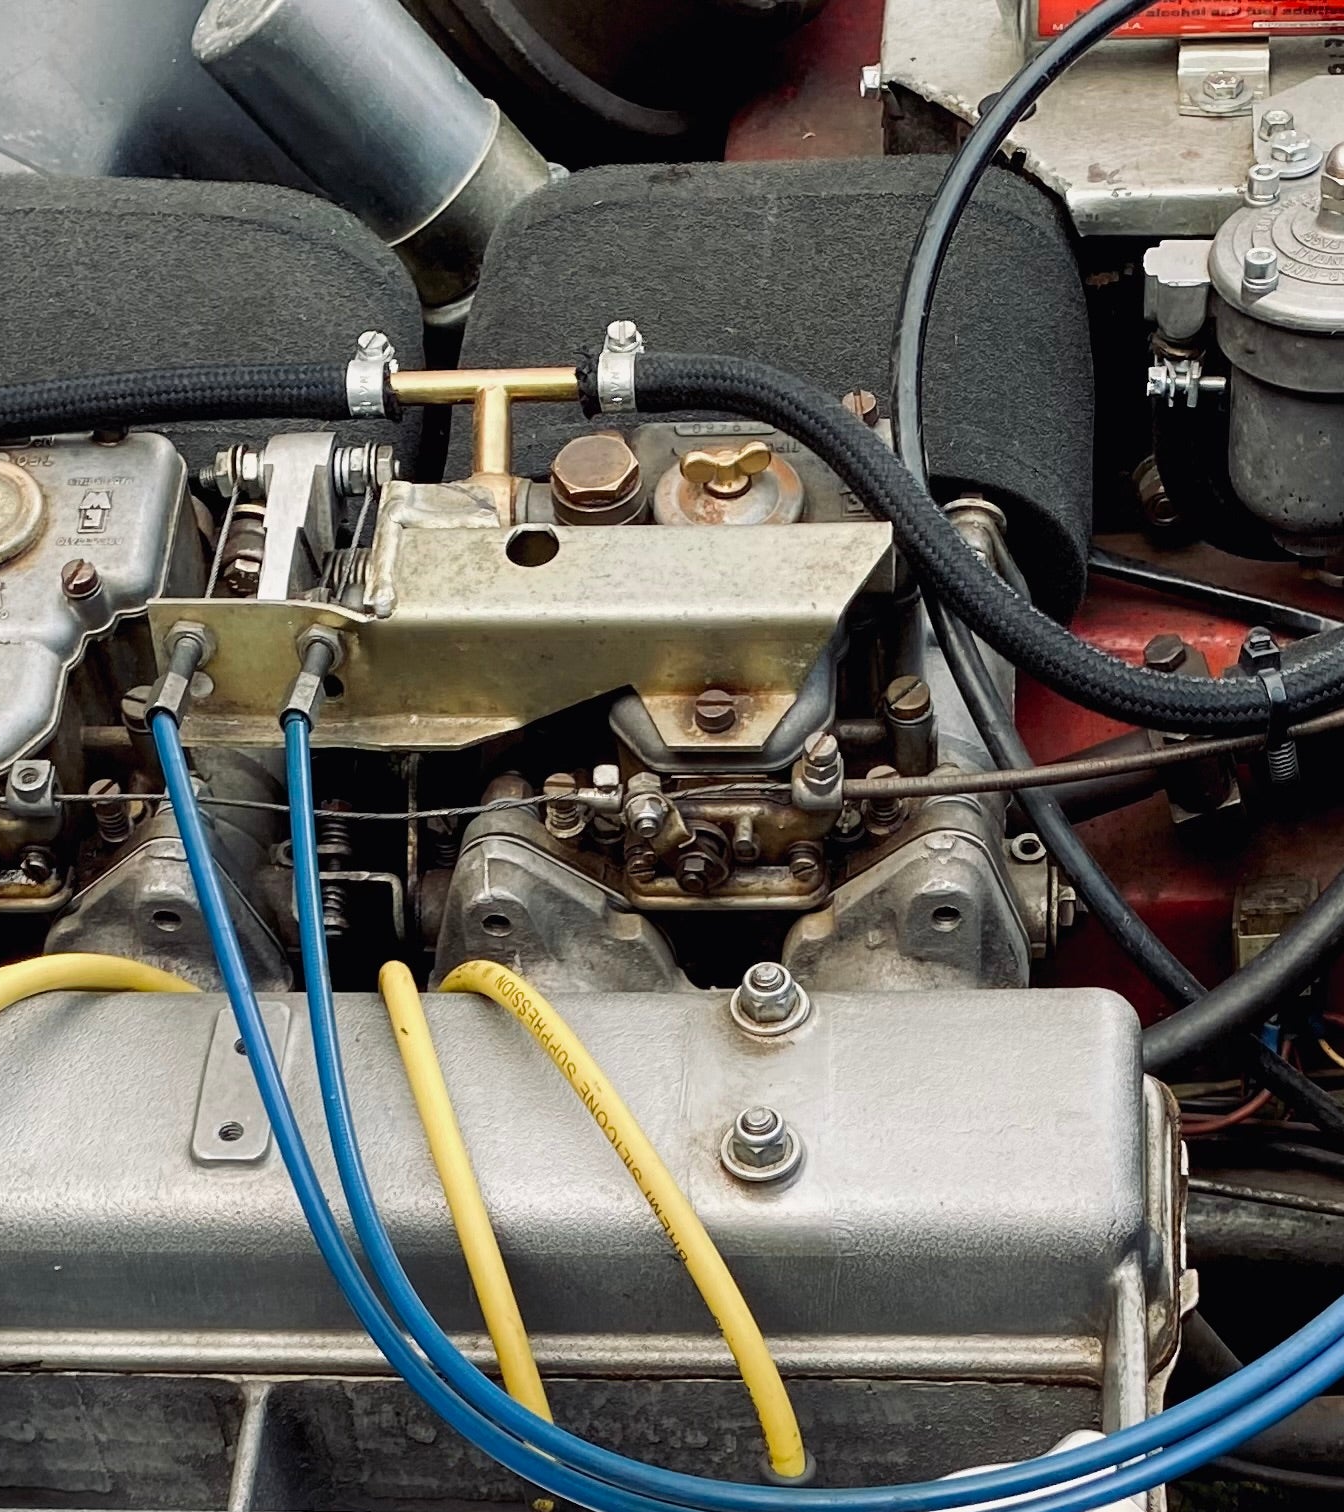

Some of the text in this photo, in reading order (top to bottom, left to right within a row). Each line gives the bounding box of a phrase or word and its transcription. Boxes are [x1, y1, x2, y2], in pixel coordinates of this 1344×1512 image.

[1146, 6, 1206, 18] alcohol
[495, 973, 577, 1079] SUPPRESSION
[581, 1080, 643, 1185] SILICONE
